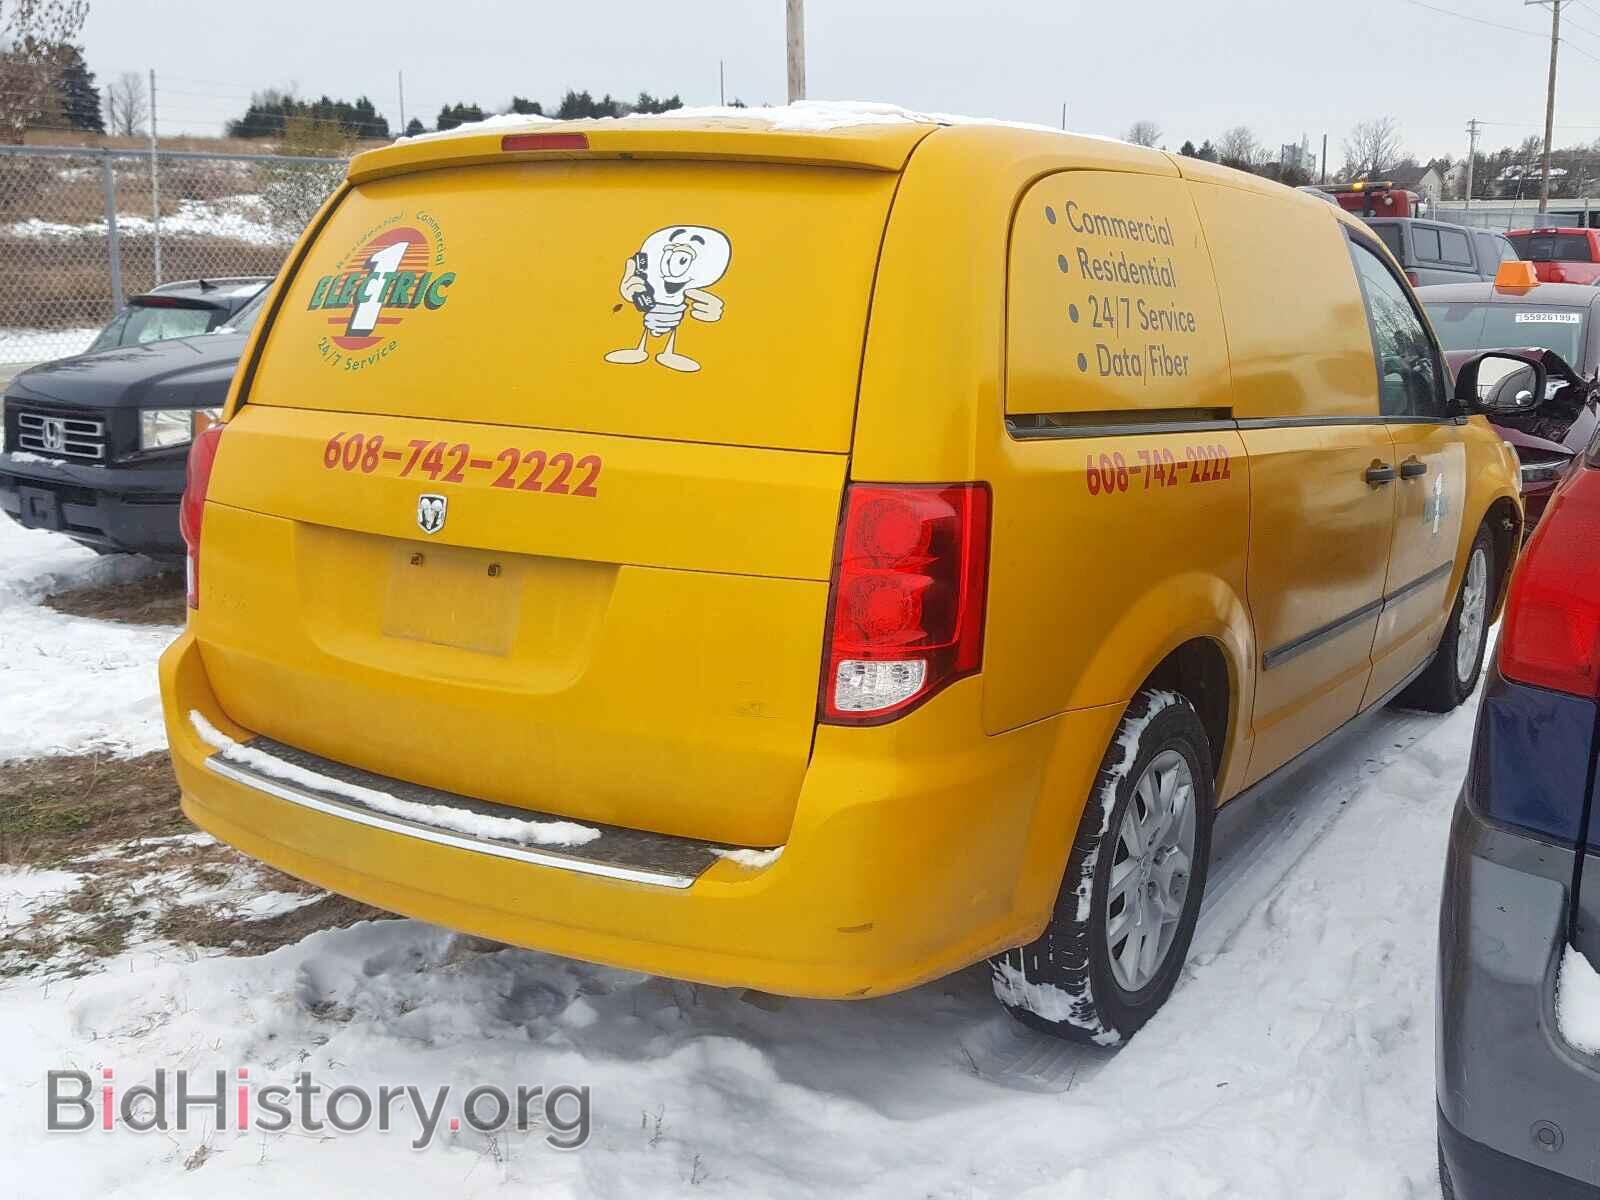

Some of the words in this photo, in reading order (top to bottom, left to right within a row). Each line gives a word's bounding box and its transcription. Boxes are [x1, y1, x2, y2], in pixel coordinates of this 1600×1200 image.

[415, 210, 447, 267] Commercial
[1065, 199, 1175, 247] Commercial
[345, 241, 411, 337] 1
[1076, 246, 1177, 288] Residential
[307, 271, 457, 311] ELECTRIC
[1087, 294, 1130, 339] 24/7
[1136, 298, 1197, 333] Service
[317, 336, 342, 367] 24/7
[344, 339, 399, 371] Service
[1095, 342, 1190, 386] Data/Fiber
[323, 431, 603, 499] 608-742-2222
[1086, 443, 1231, 496] 608-742-2222
